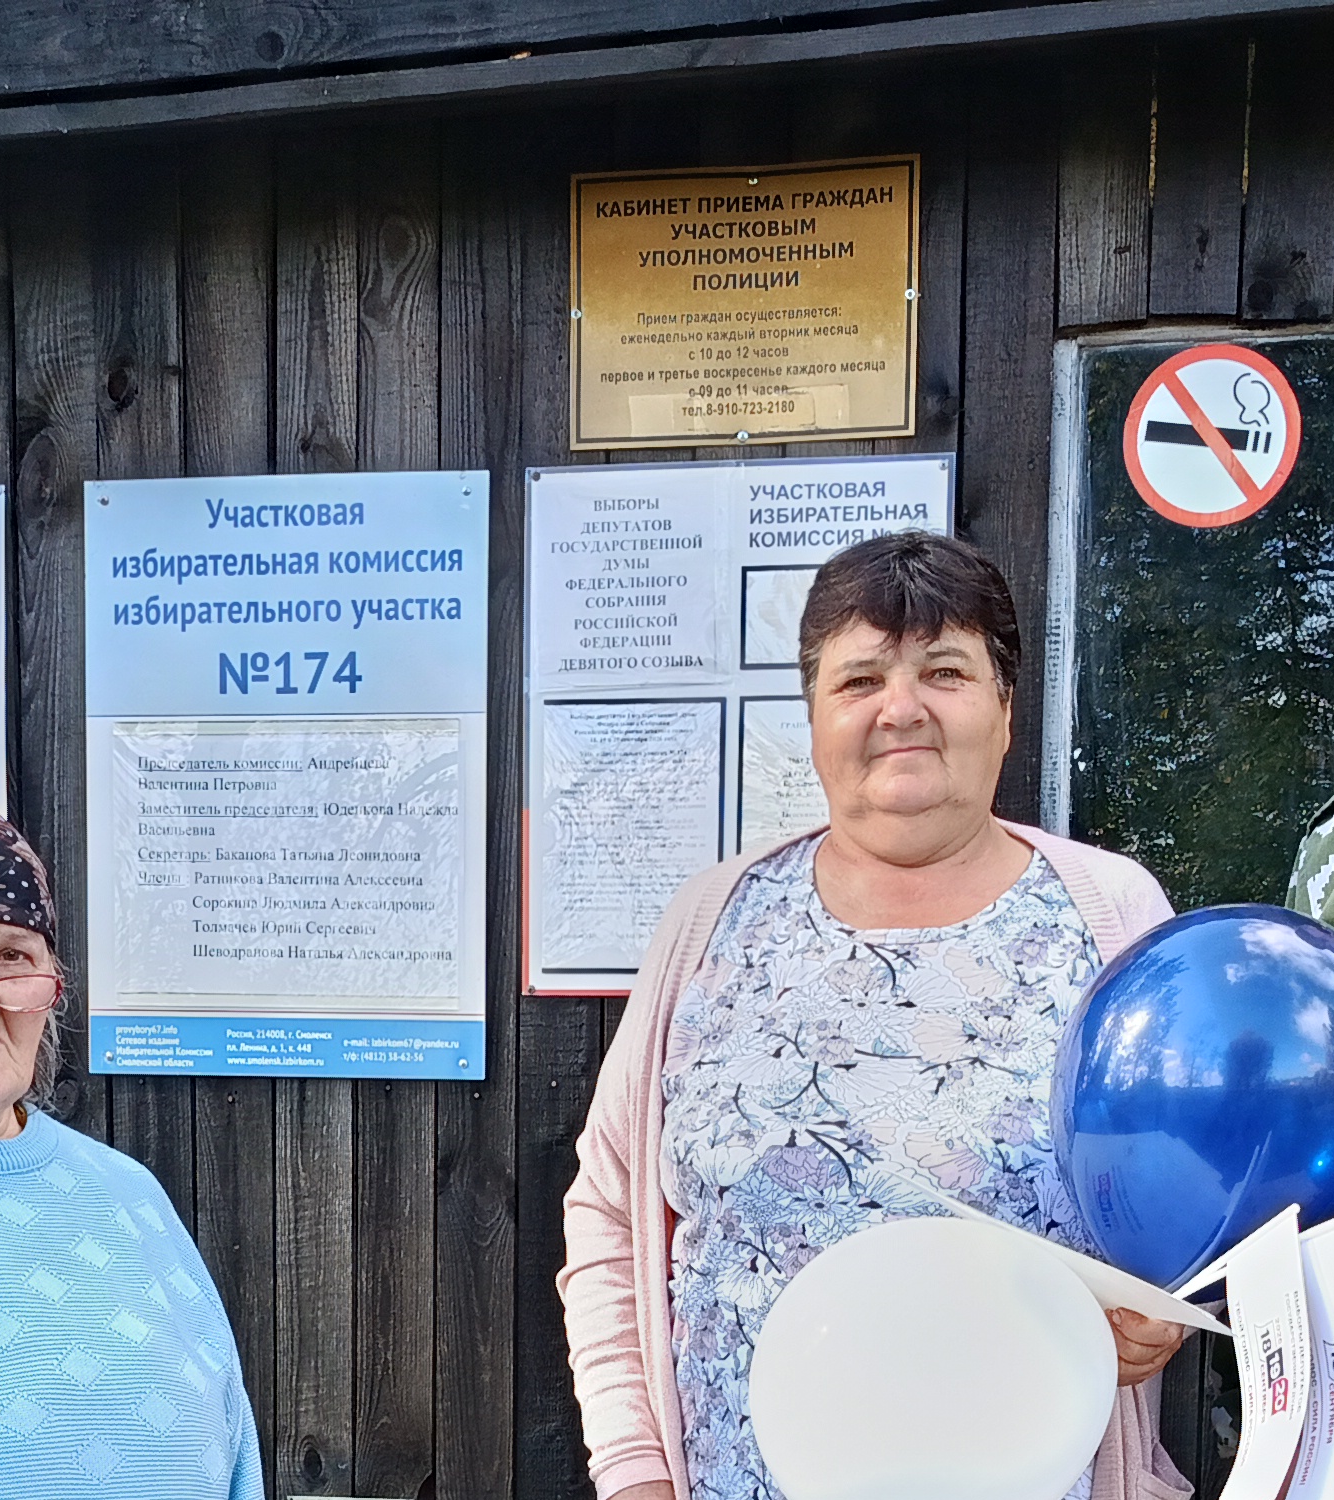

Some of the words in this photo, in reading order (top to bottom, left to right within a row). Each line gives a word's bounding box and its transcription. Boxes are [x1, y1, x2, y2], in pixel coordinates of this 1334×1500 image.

[596, 198, 691, 218] КАБИНЕТ
[698, 194, 784, 213] ПРИЕМА
[791, 186, 893, 208] ГРАЖДАН
[671, 218, 816, 240] УЧАСТКОВЫМ
[639, 241, 854, 267] УПОЛНОМОЧЕННЫМ
[693, 271, 799, 291] ПОЛИЦИИ
[637, 313, 677, 325] Прием
[680, 311, 731, 326] граждан
[735, 306, 842, 323] осуществляется:
[620, 331, 703, 345] еженедельно
[706, 327, 755, 343] каждый
[759, 328, 810, 343] вторник
[813, 324, 858, 337] месяца
[700, 348, 712, 360] 10
[716, 349, 731, 362] до
[737, 346, 749, 359] 12
[753, 347, 789, 359] часов
[600, 371, 643, 385] первое
[647, 371, 655, 381] и
[658, 368, 699, 383] третье
[703, 366, 782, 382] воскресенье
[786, 361, 836, 377] каждого
[840, 360, 885, 374] месяца
[716, 386, 732, 399] до
[737, 384, 747, 396] 11
[749, 481, 886, 501] УЧАСТКОВАЯ
[205, 498, 364, 528] Участковая
[593, 497, 660, 512] ВЫБОРЫ
[749, 503, 928, 525] ИЗБИРАТЕЛЬНАЯ
[580, 518, 673, 536] ДЕПУТАТОВ
[551, 534, 703, 554] ГОСУДАРСТВЕННОЙ
[749, 529, 864, 548] КОМИССИЯ
[112, 548, 319, 584] избирательная
[329, 549, 463, 574] комиссия
[602, 557, 650, 572] ДУМЫ
[565, 574, 687, 591] ФЕДЕРАЛЬНОГО
[585, 594, 667, 609] СОБРАНИЯ
[113, 595, 342, 632] избирательного
[352, 596, 462, 629] участка
[574, 613, 678, 631] РОССИЙСКОЙ
[579, 634, 672, 650] ФЕДЕРАЦИИ
[219, 651, 363, 695] №174
[558, 655, 638, 673] ДЕВЯТОГО
[641, 654, 704, 669] СОЗЫВА
[138, 777, 209, 790] Валентина
[213, 778, 277, 793] Петровна
[138, 802, 221, 815] Заместитель
[138, 823, 215, 835] Васильевна
[138, 847, 211, 863] Секретарь:
[282, 848, 334, 861] Татьяна
[338, 849, 421, 863] Леонидовна
[195, 872, 263, 885] Ратникова
[268, 872, 339, 886] Валентина
[343, 873, 423, 886] Алексеевна
[261, 896, 326, 911] Людмила
[192, 920, 257, 933] Толмачев
[261, 921, 301, 936] Юрий
[306, 921, 376, 938] Сергеевич
[288, 945, 343, 960] Наталья
[1260, 1328, 1273, 1353] 18
[1274, 1379, 1287, 1411] 20
